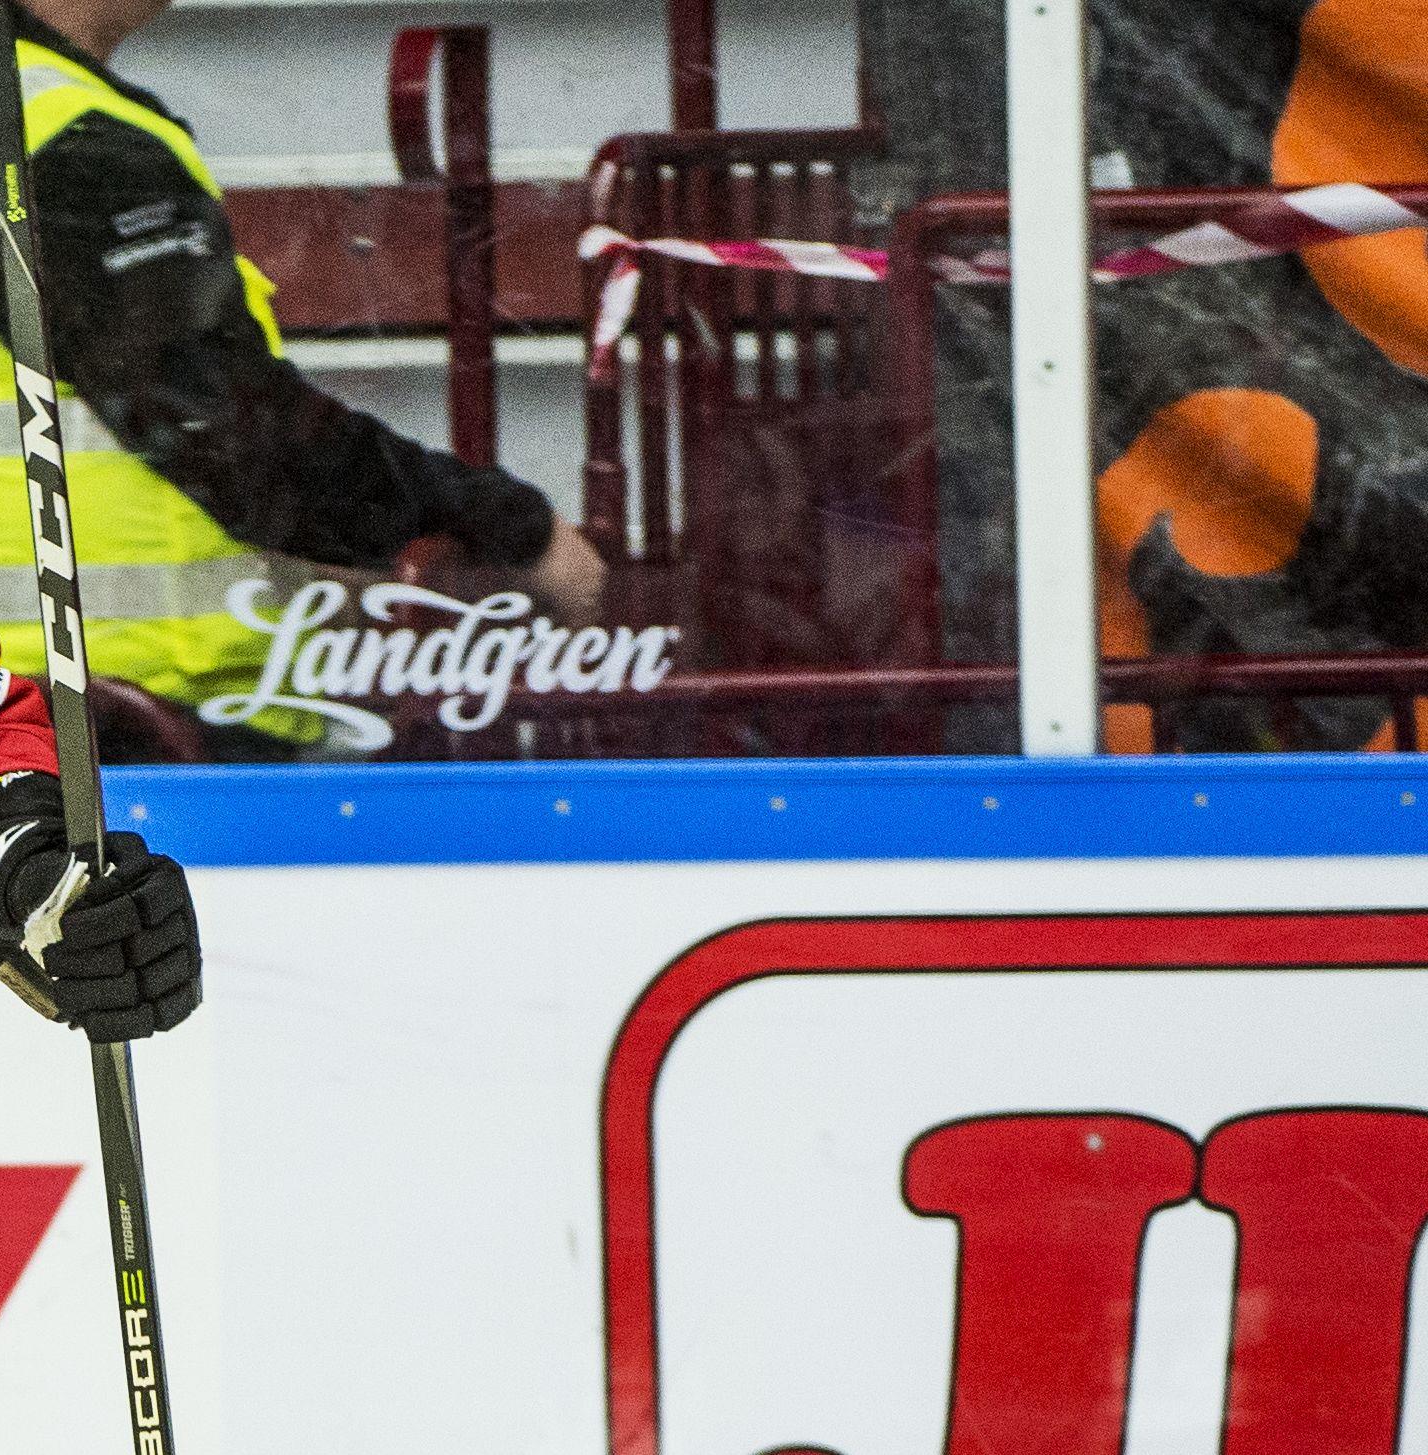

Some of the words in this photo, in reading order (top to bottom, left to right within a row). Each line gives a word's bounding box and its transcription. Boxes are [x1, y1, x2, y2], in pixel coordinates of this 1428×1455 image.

[15, 361, 87, 695] CCM
[199, 580, 676, 752] Landgren
[121, 1204, 136, 1261] TRIGGER
